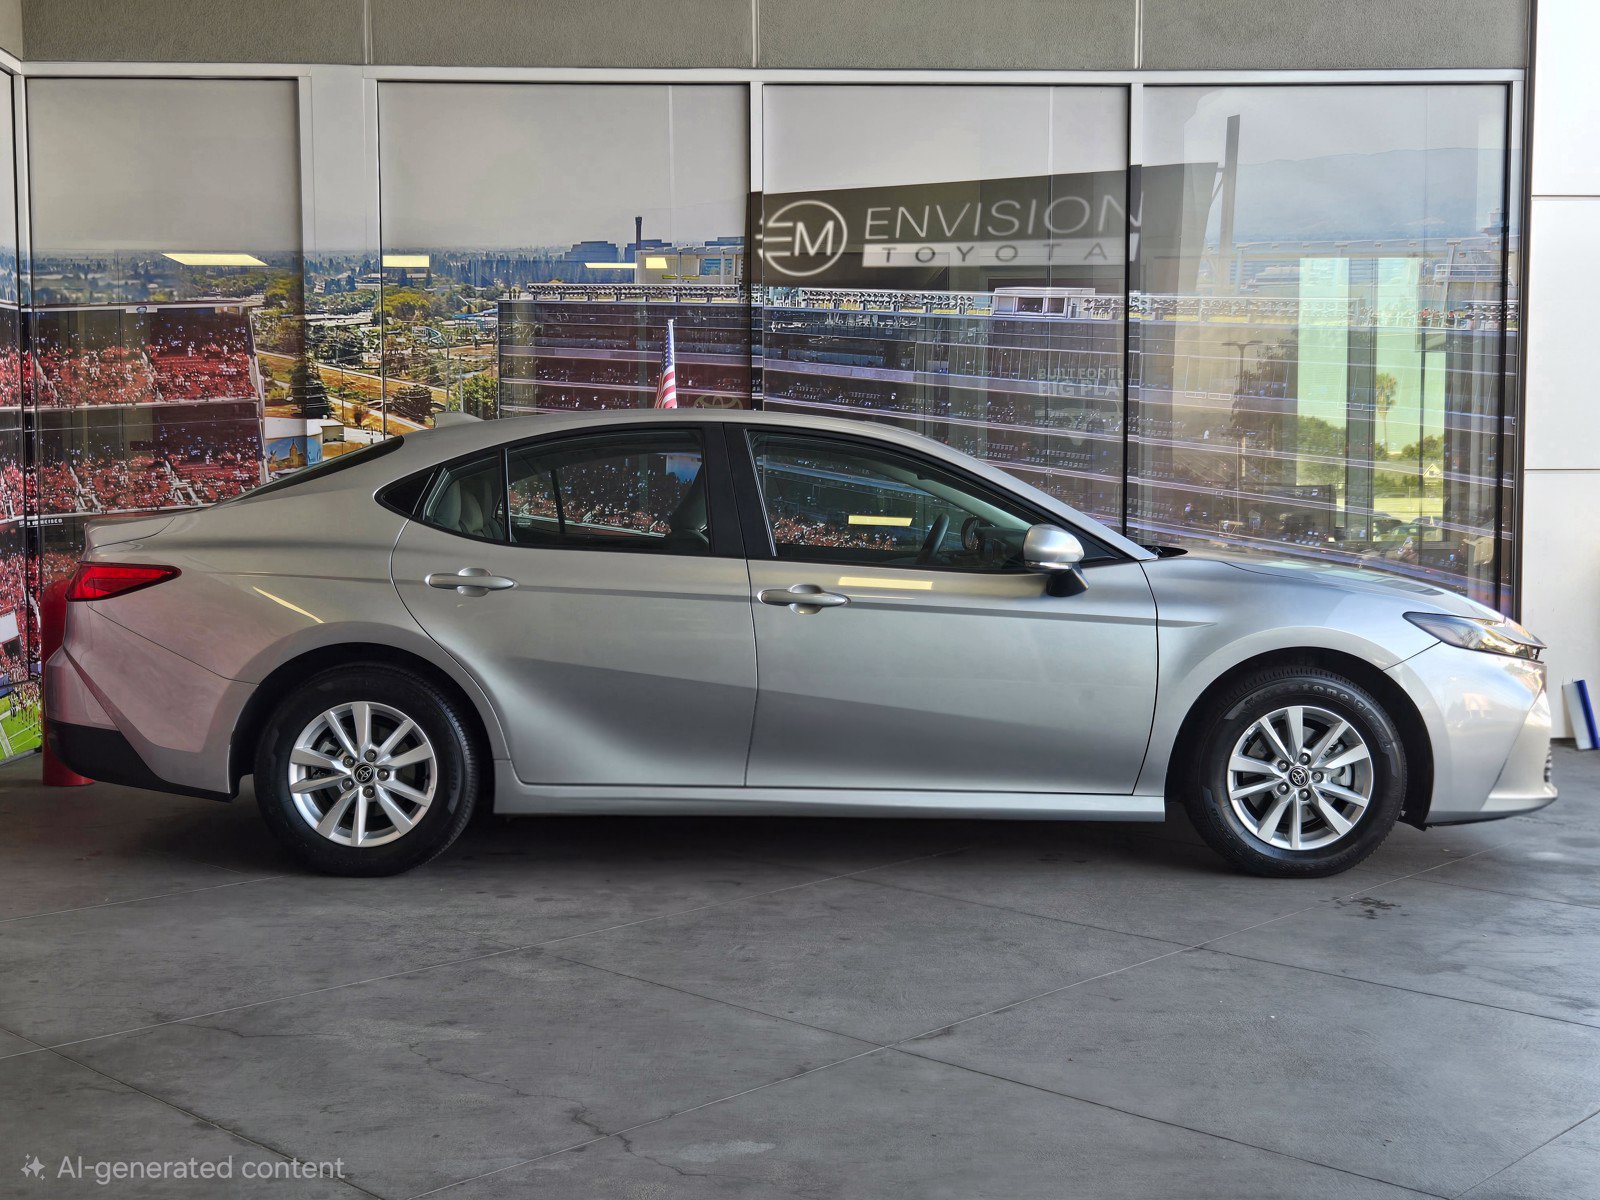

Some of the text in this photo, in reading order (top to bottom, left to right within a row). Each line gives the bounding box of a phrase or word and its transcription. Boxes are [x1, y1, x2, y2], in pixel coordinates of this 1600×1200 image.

[865, 192, 1143, 240] ENVISION
[883, 242, 1108, 263] TOYOTA
[1108, 367, 1123, 379] TH
